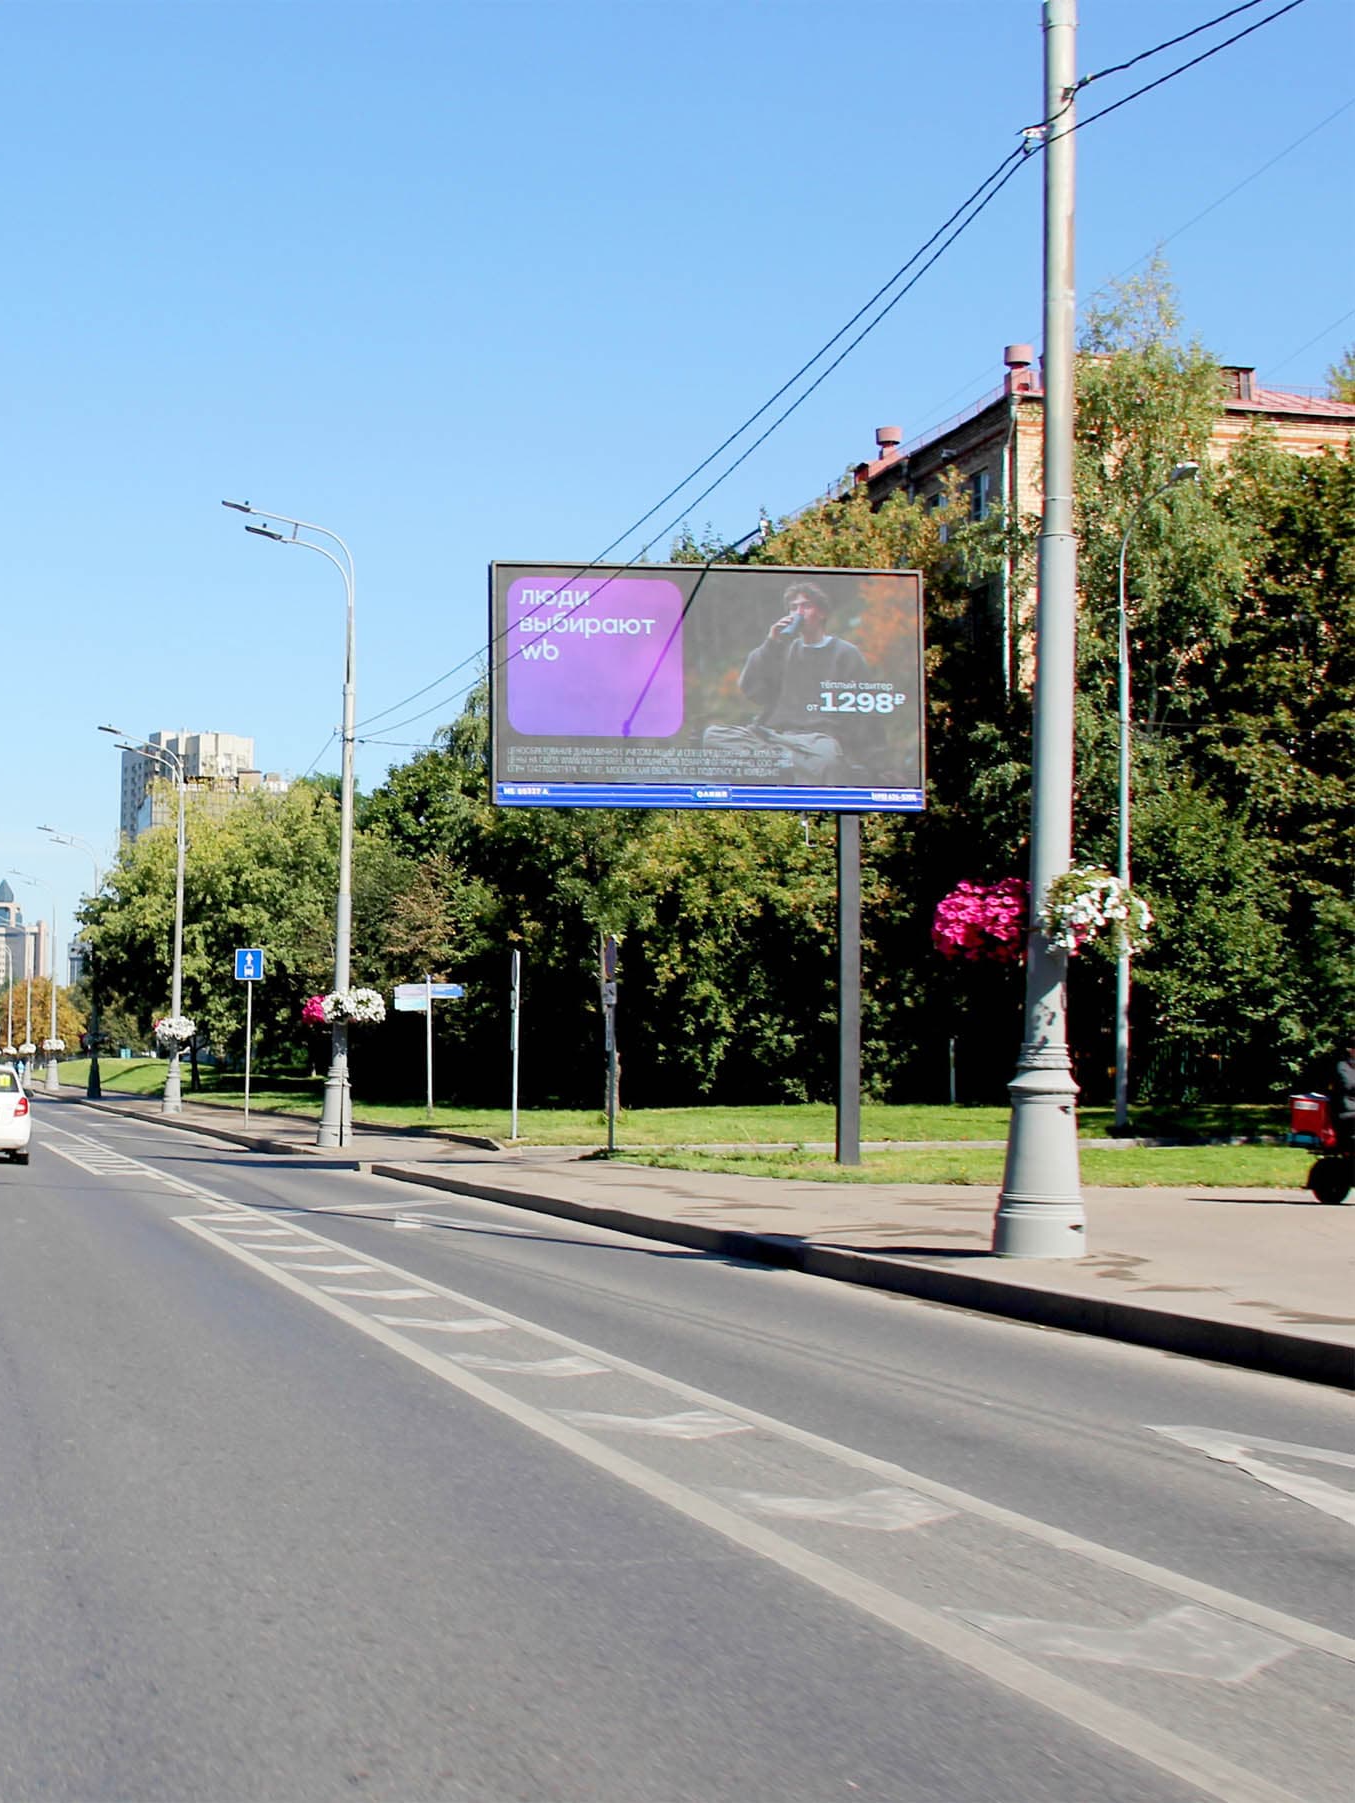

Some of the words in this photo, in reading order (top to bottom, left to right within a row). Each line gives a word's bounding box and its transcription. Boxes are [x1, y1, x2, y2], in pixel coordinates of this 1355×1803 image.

[520, 590, 590, 607] люди
[520, 612, 655, 637] выбирают
[519, 639, 559, 661] wb
[858, 682, 893, 692] свитер
[806, 704, 819, 712] от
